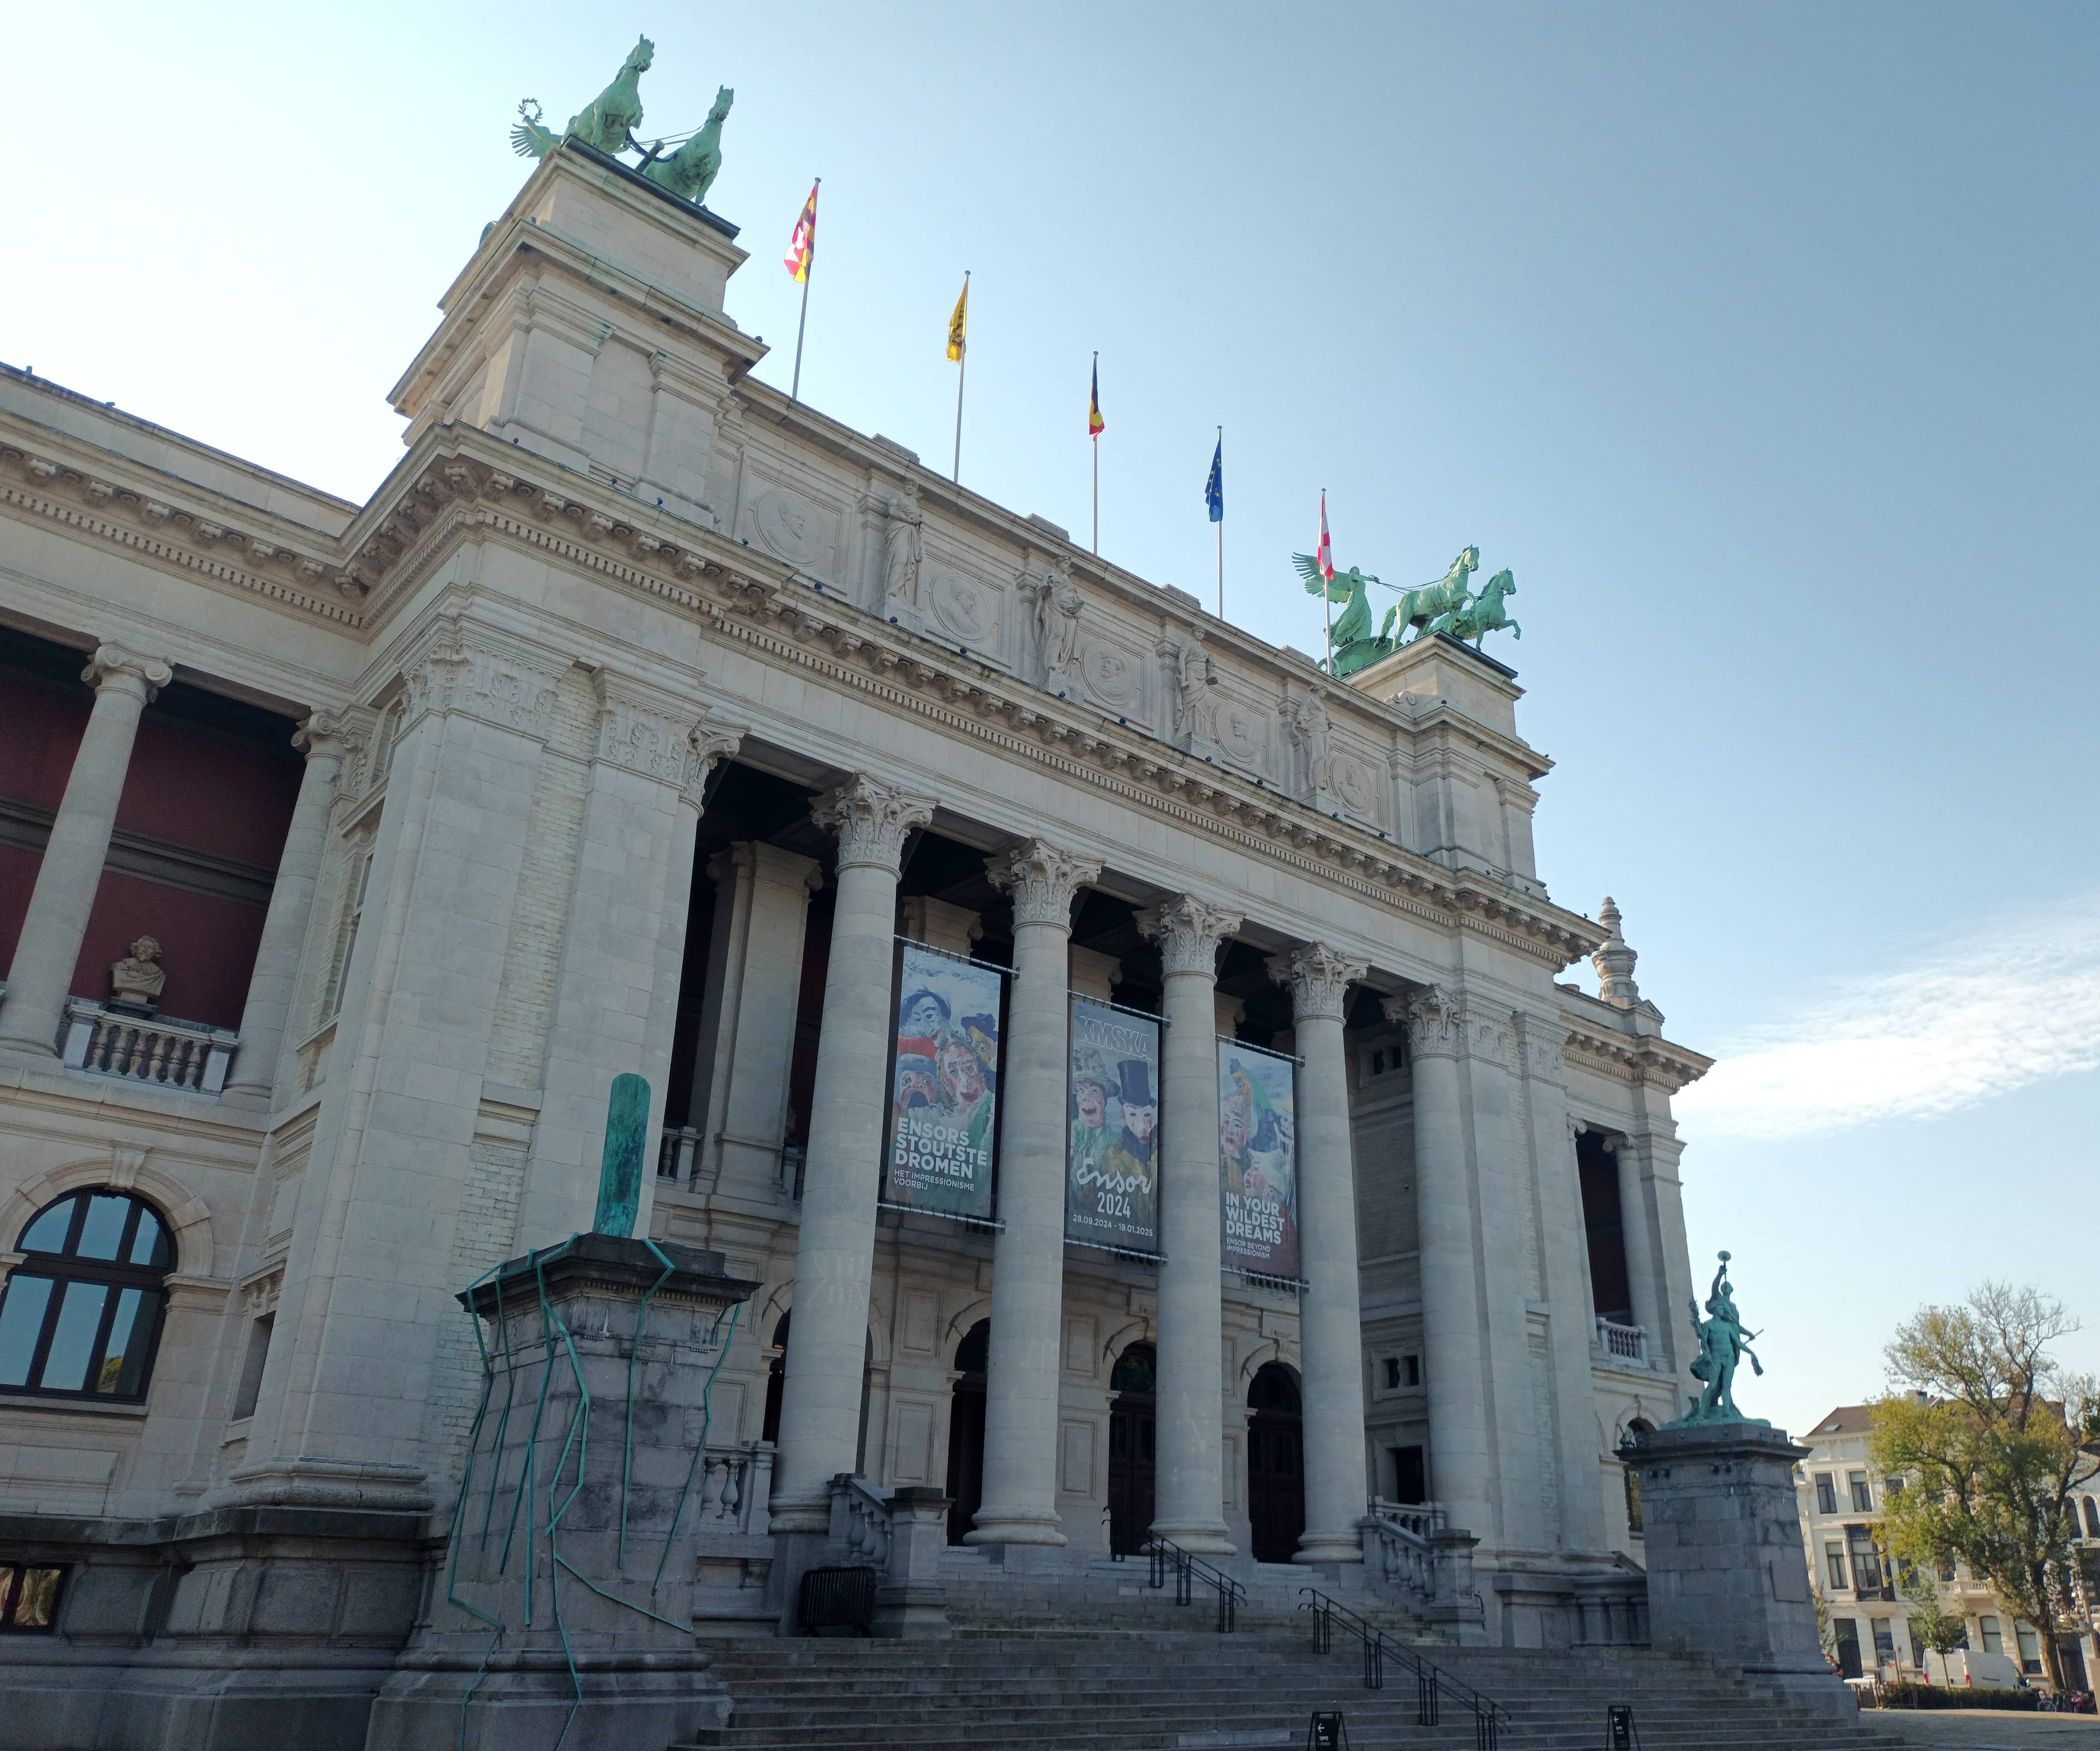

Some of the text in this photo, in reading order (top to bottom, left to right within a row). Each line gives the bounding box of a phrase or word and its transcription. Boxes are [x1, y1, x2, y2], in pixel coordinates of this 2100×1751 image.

[1080, 1015, 1153, 1061] KMSKA
[897, 1117, 969, 1145] ENSORS
[896, 1133, 988, 1166] STOUTSTE
[895, 1149, 973, 1179] DROMEN
[1076, 1157, 1152, 1194] Ensor
[894, 1169, 975, 1191] HET IMPRESSIONISME
[894, 1177, 928, 1190] VOORBIJ
[1097, 1191, 1131, 1218] 2024
[1226, 1191, 1279, 1217] IN YOUR
[1073, 1214, 1112, 1229] 28.09.2024
[1118, 1223, 1153, 1237] 19.01.2025
[1226, 1206, 1285, 1231] WILDEST
[1226, 1220, 1281, 1244] DREAMS
[1227, 1237, 1270, 1252] ENSOR BEYOND
[1226, 1244, 1270, 1260] IMPRESSIONISM
